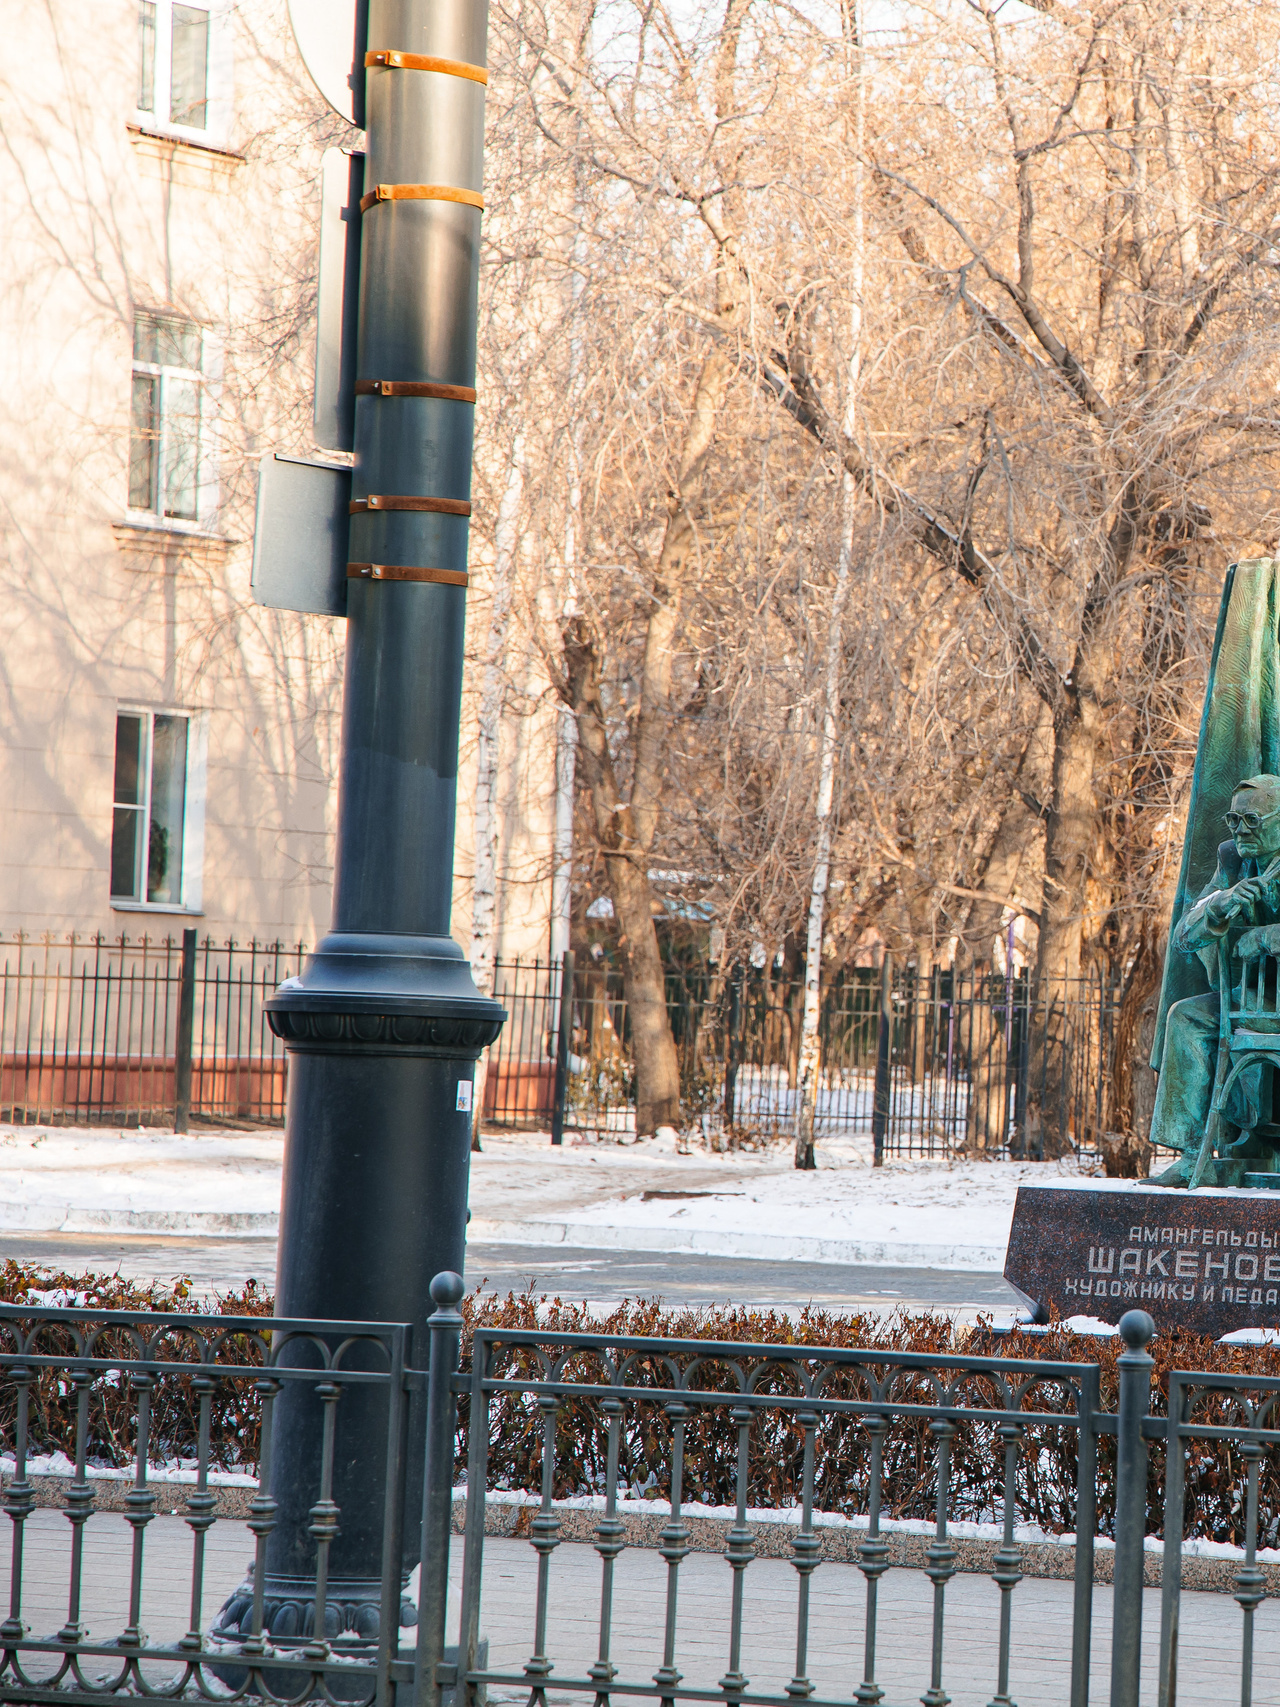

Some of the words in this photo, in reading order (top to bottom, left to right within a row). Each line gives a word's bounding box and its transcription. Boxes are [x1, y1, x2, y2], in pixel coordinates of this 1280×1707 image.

[1129, 1226, 1278, 1248] АМАНГЕЛЬДЫ
[1065, 1278, 1195, 1301] ХУДОЖНИКУ
[1202, 1284, 1214, 1302] И
